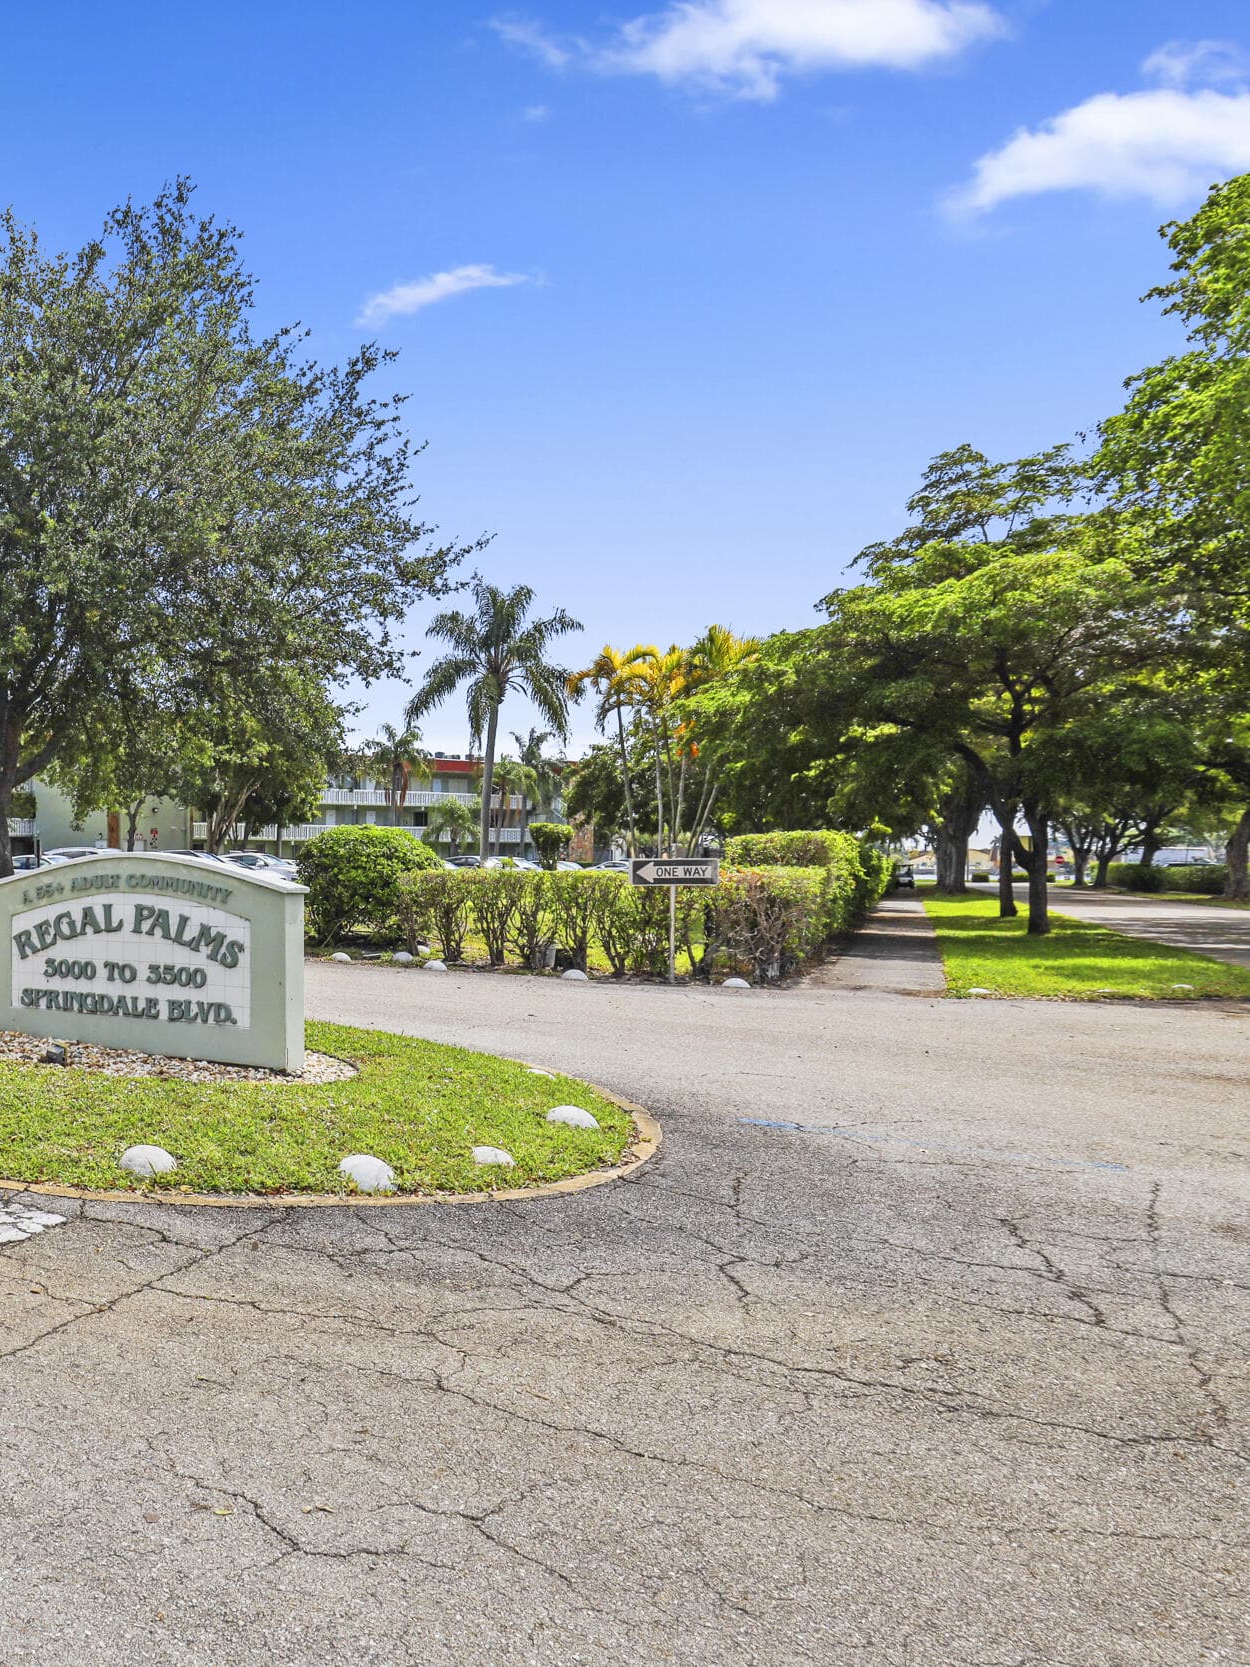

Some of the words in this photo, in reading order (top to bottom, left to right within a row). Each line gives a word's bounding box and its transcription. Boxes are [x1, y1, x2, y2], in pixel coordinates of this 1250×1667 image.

[656, 867, 679, 877] ONE
[683, 867, 708, 877] WAY
[23, 889, 34, 904] A
[35, 882, 65, 900] 55+
[70, 874, 121, 893] ADULT
[125, 873, 233, 904] COMMUNITY
[13, 903, 124, 960] REGAL
[131, 903, 245, 969] PALMS
[43, 957, 97, 980] 3000
[103, 960, 137, 983] TO
[146, 964, 207, 988] 3500
[20, 988, 161, 1020] SPRINGDALE
[166, 998, 238, 1024] BLVD.
